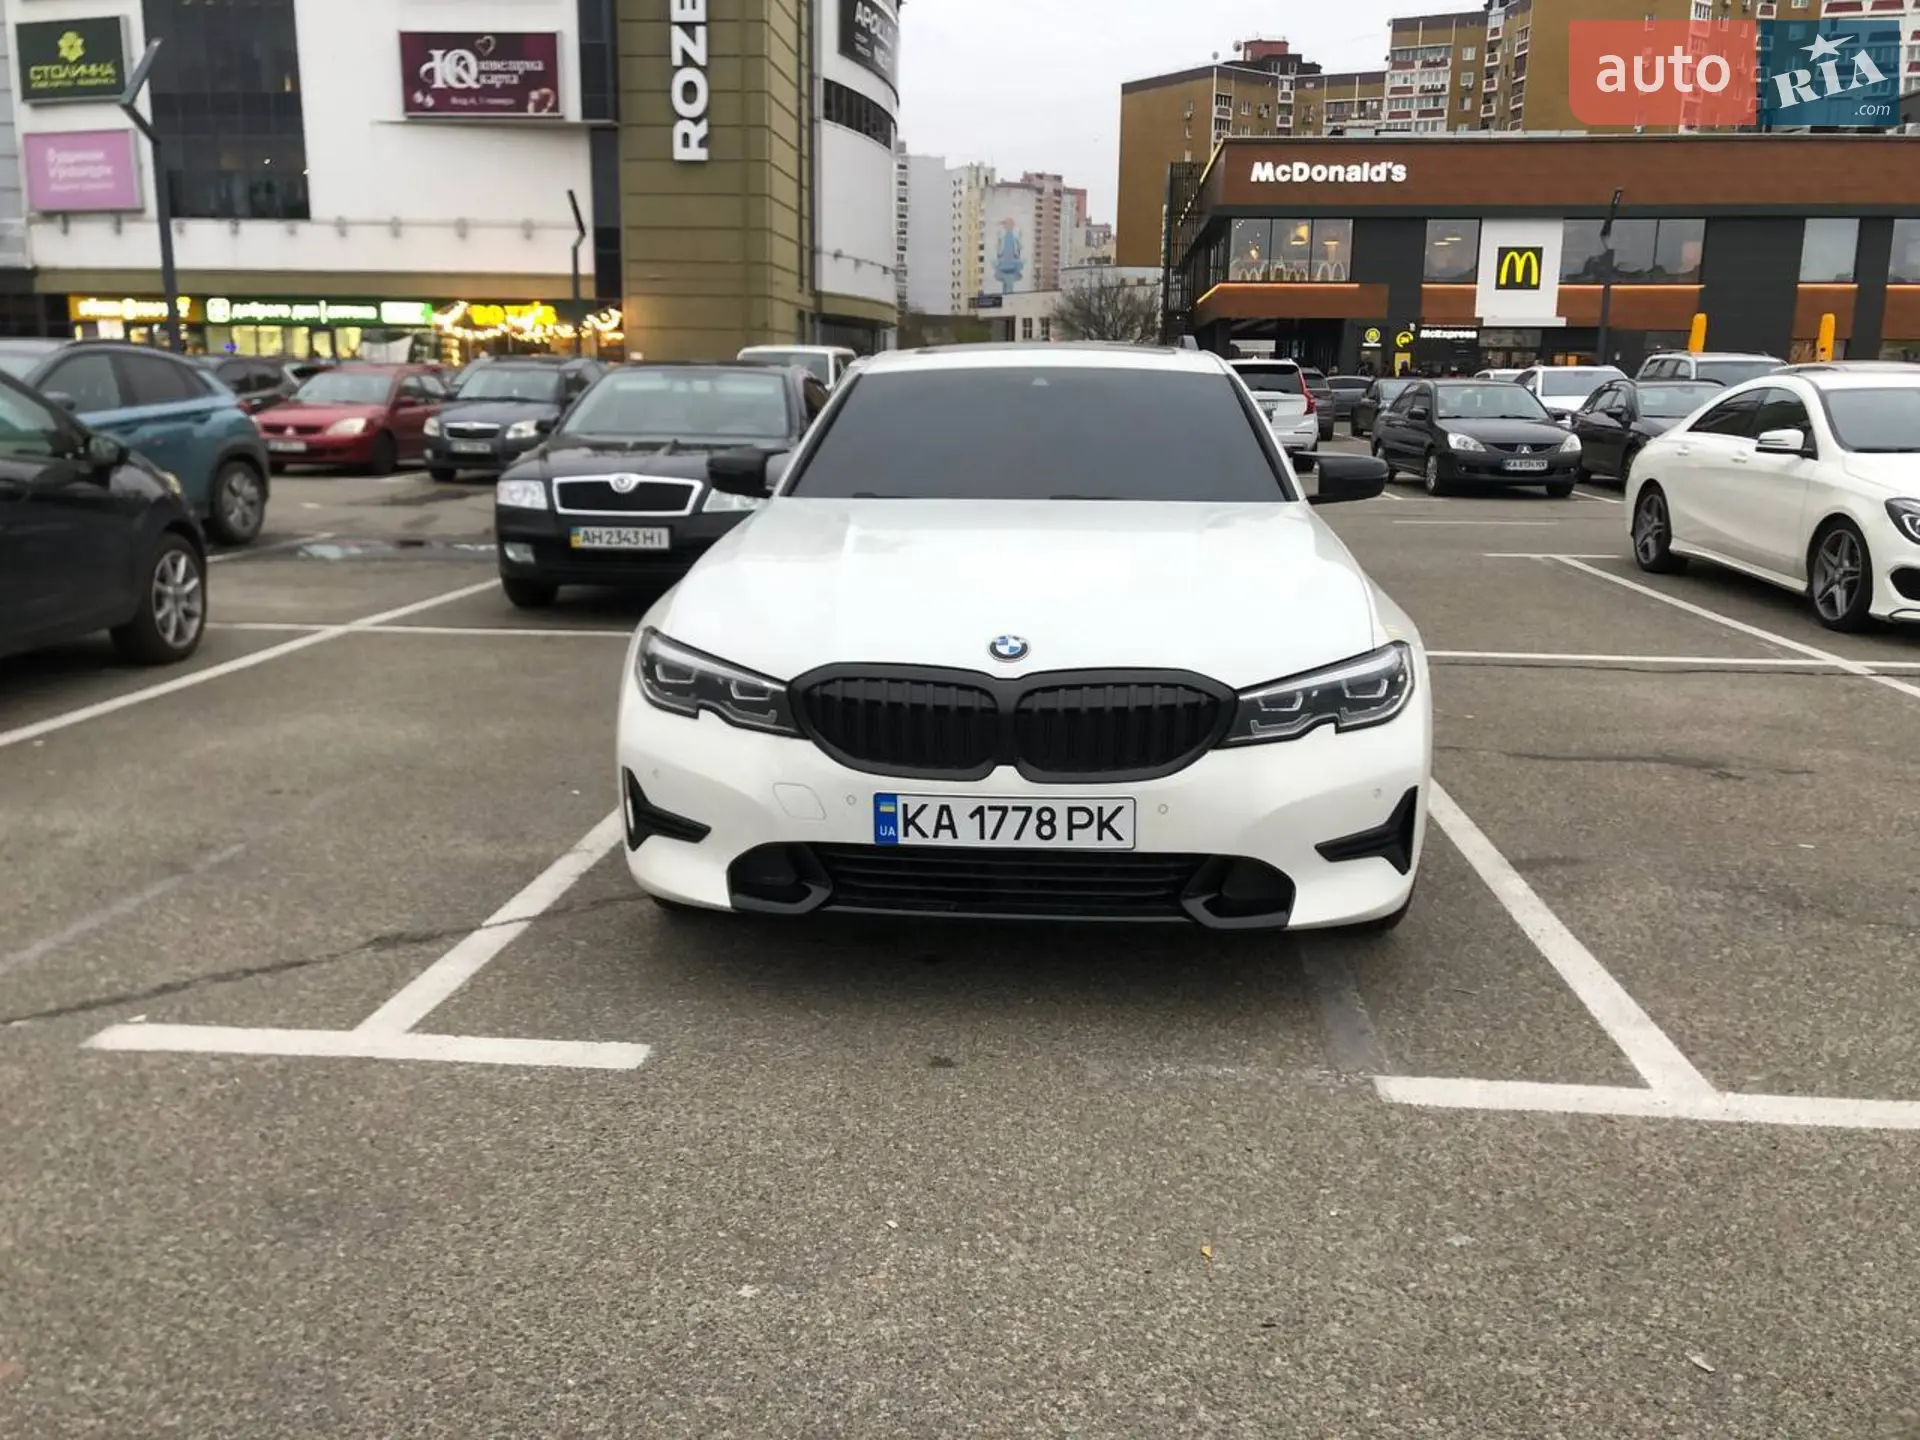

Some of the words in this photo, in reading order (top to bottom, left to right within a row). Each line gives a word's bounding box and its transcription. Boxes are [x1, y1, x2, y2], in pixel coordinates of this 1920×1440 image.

[670, 0, 709, 161] ROZE
[1250, 161, 1407, 182] McDonald's
[583, 530, 603, 544] AH
[605, 531, 641, 545] 2343
[879, 825, 896, 837] UA
[902, 803, 959, 840] KA
[968, 805, 1057, 841] 1778
[1066, 806, 1125, 842] PK
